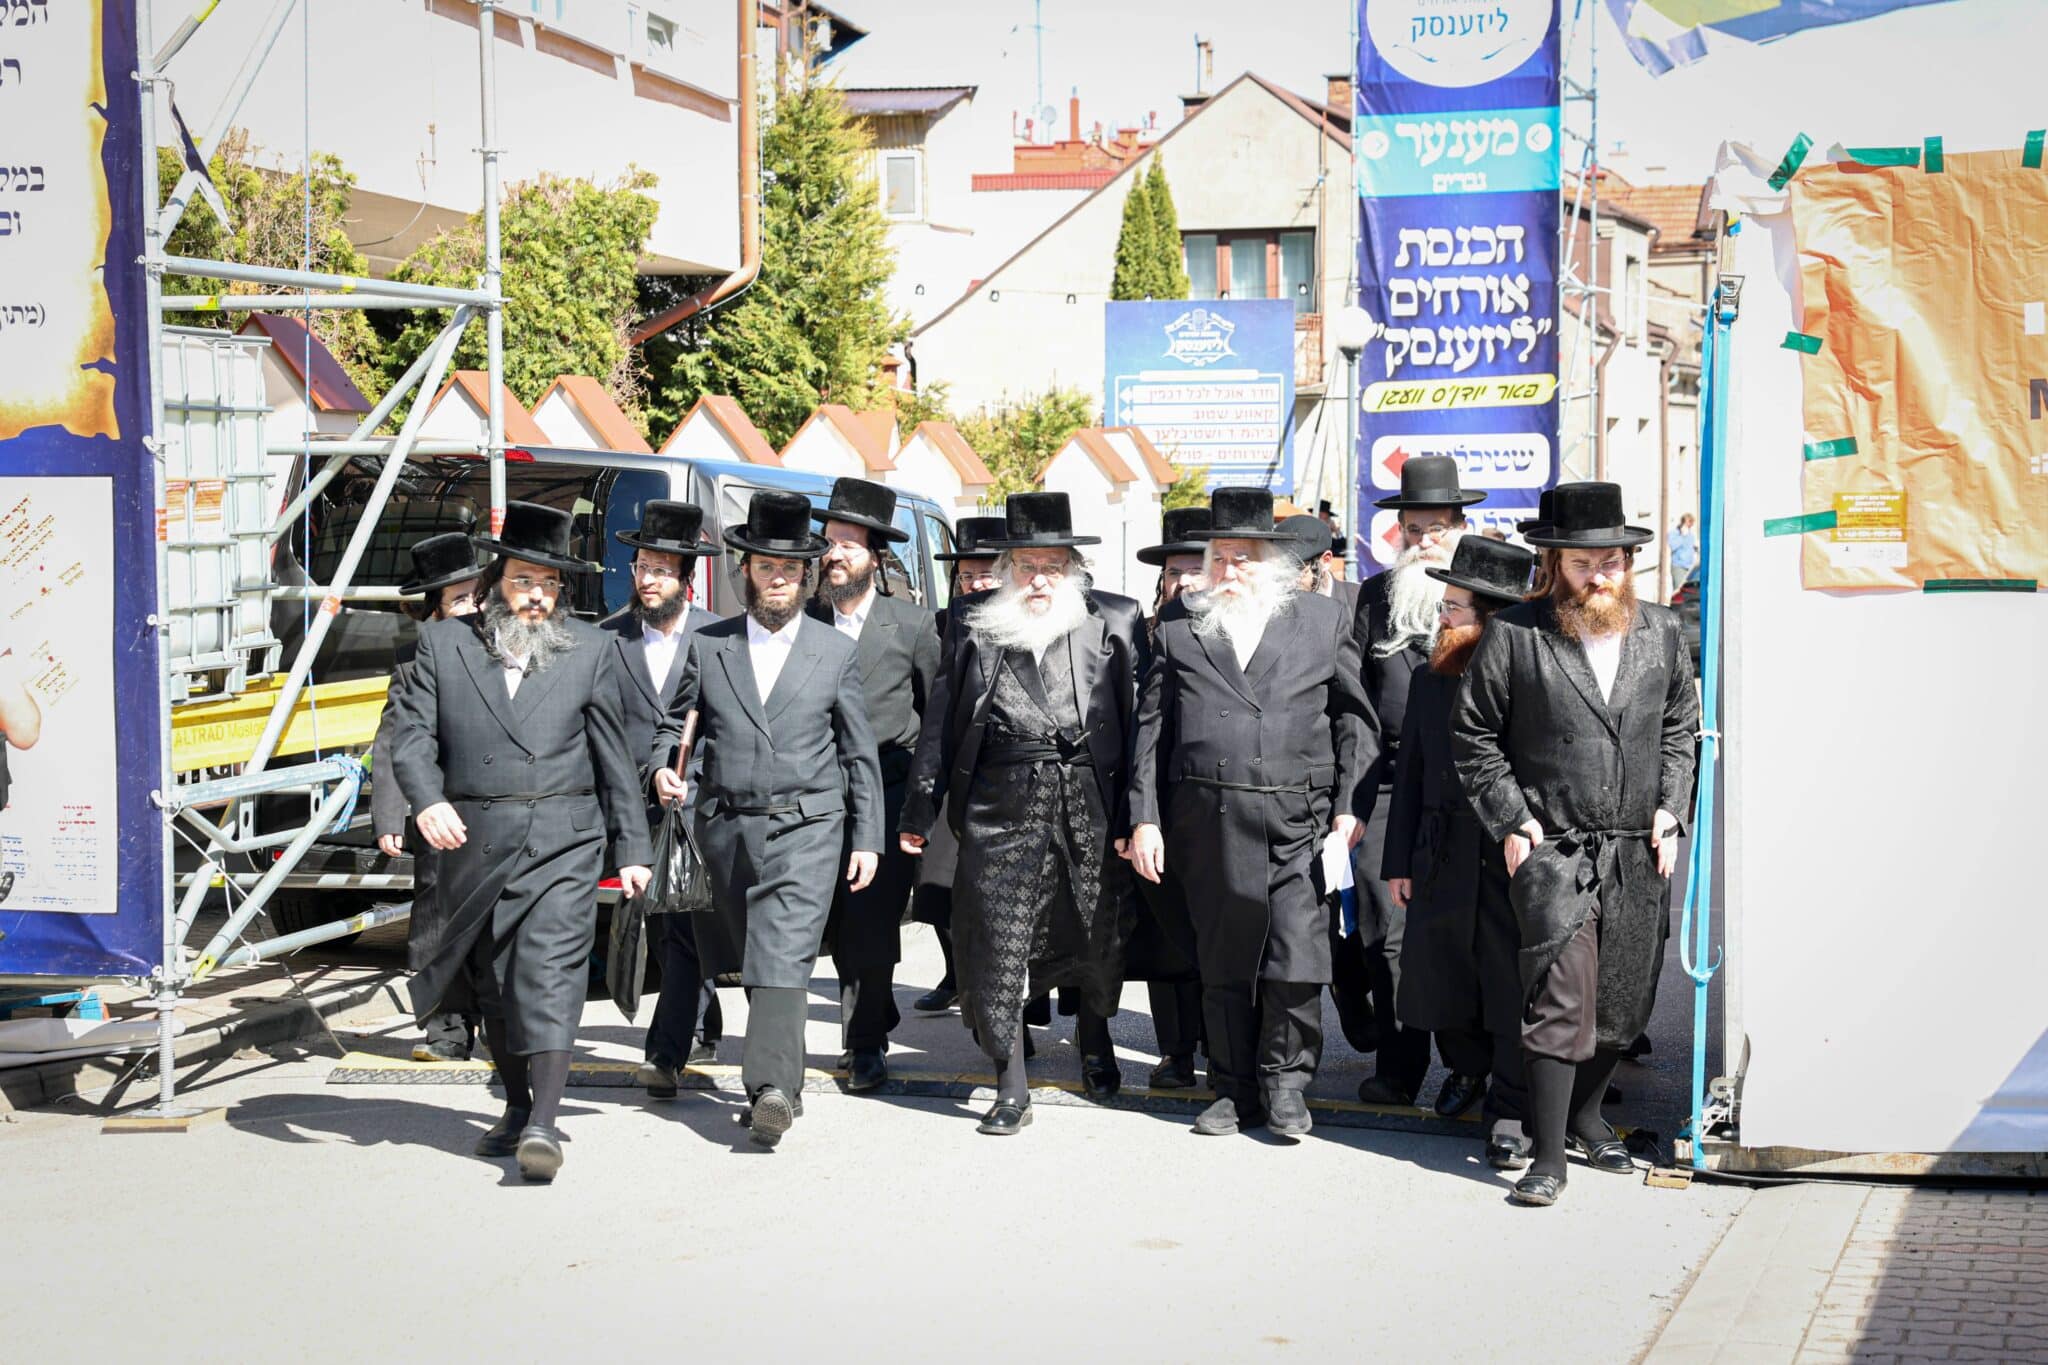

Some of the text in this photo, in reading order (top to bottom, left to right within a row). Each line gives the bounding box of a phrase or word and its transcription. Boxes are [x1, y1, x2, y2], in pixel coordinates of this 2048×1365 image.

[1411, 7, 1508, 43] ליזענסק
[1395, 118, 1519, 167] מענער
[1395, 225, 1524, 268] הכנסת
[1389, 273, 1530, 317] אורחים
[1421, 444, 1535, 472] שטיבל
[174, 725, 224, 748] ALTRAD
